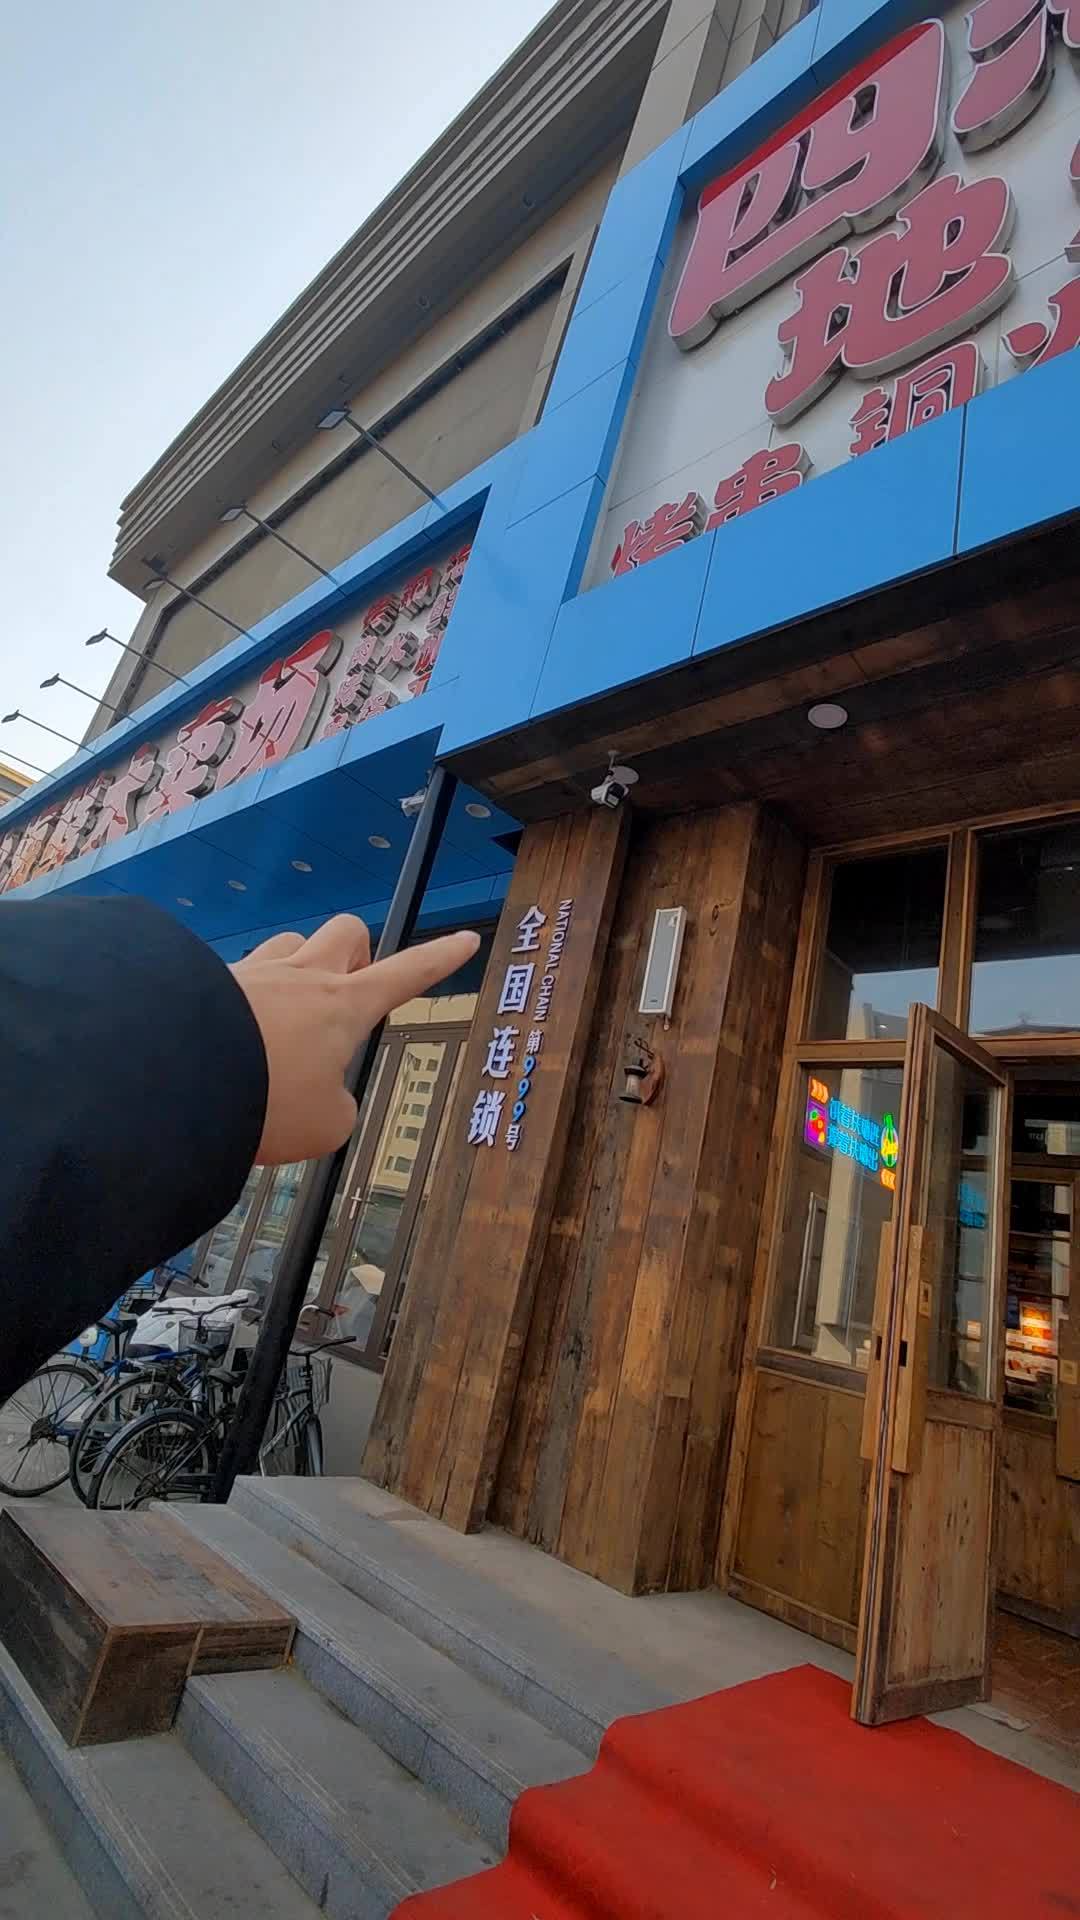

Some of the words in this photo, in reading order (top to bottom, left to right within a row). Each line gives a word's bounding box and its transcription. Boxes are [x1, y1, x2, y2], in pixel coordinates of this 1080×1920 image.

[544, 898, 573, 971] NATIONAL
[467, 905, 547, 1147] 全国连锁
[533, 973, 556, 1022] CHAIN
[505, 1029, 543, 1151] 第999号
